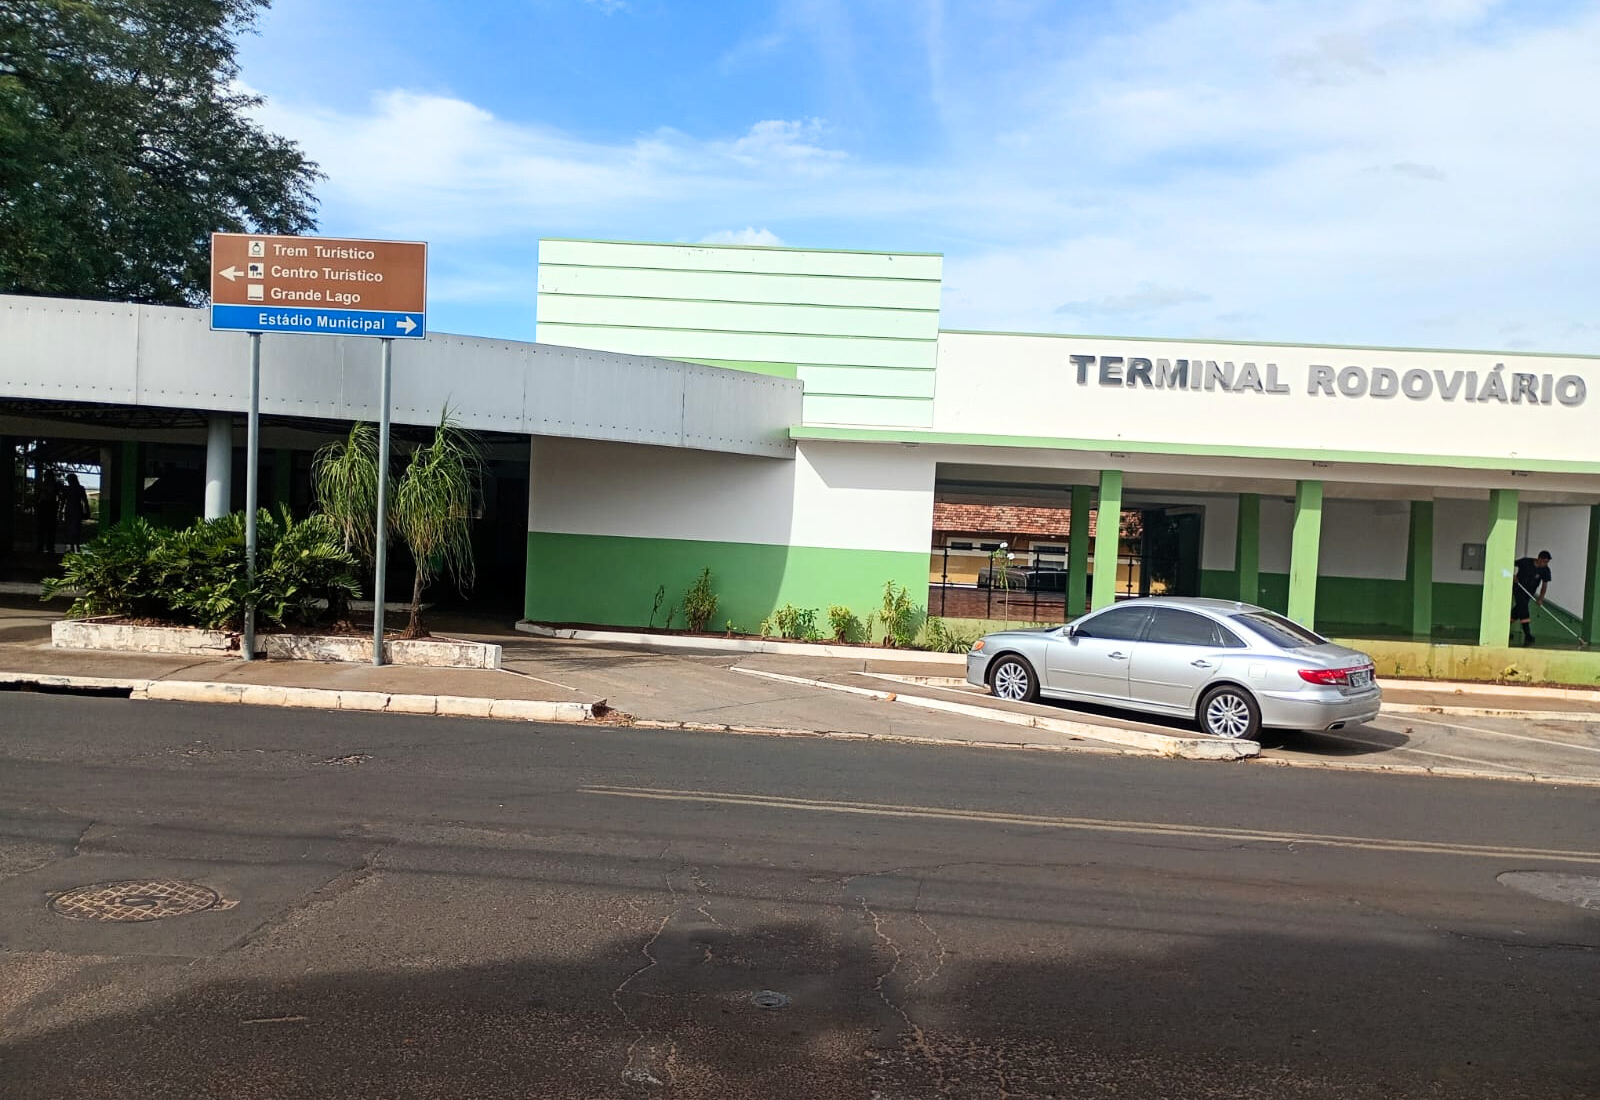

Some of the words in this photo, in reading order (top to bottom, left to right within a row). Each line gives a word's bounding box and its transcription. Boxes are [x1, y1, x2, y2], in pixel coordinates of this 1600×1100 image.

[273, 244, 308, 257] Trem
[271, 265, 319, 279] Centro
[270, 287, 321, 301] Grande
[326, 290, 361, 305] Lago
[258, 313, 312, 327] Estádio
[317, 316, 385, 331] Municipal
[1069, 354, 1290, 395] TERMINAL
[1306, 363, 1587, 408] RODOVIÁRIO
